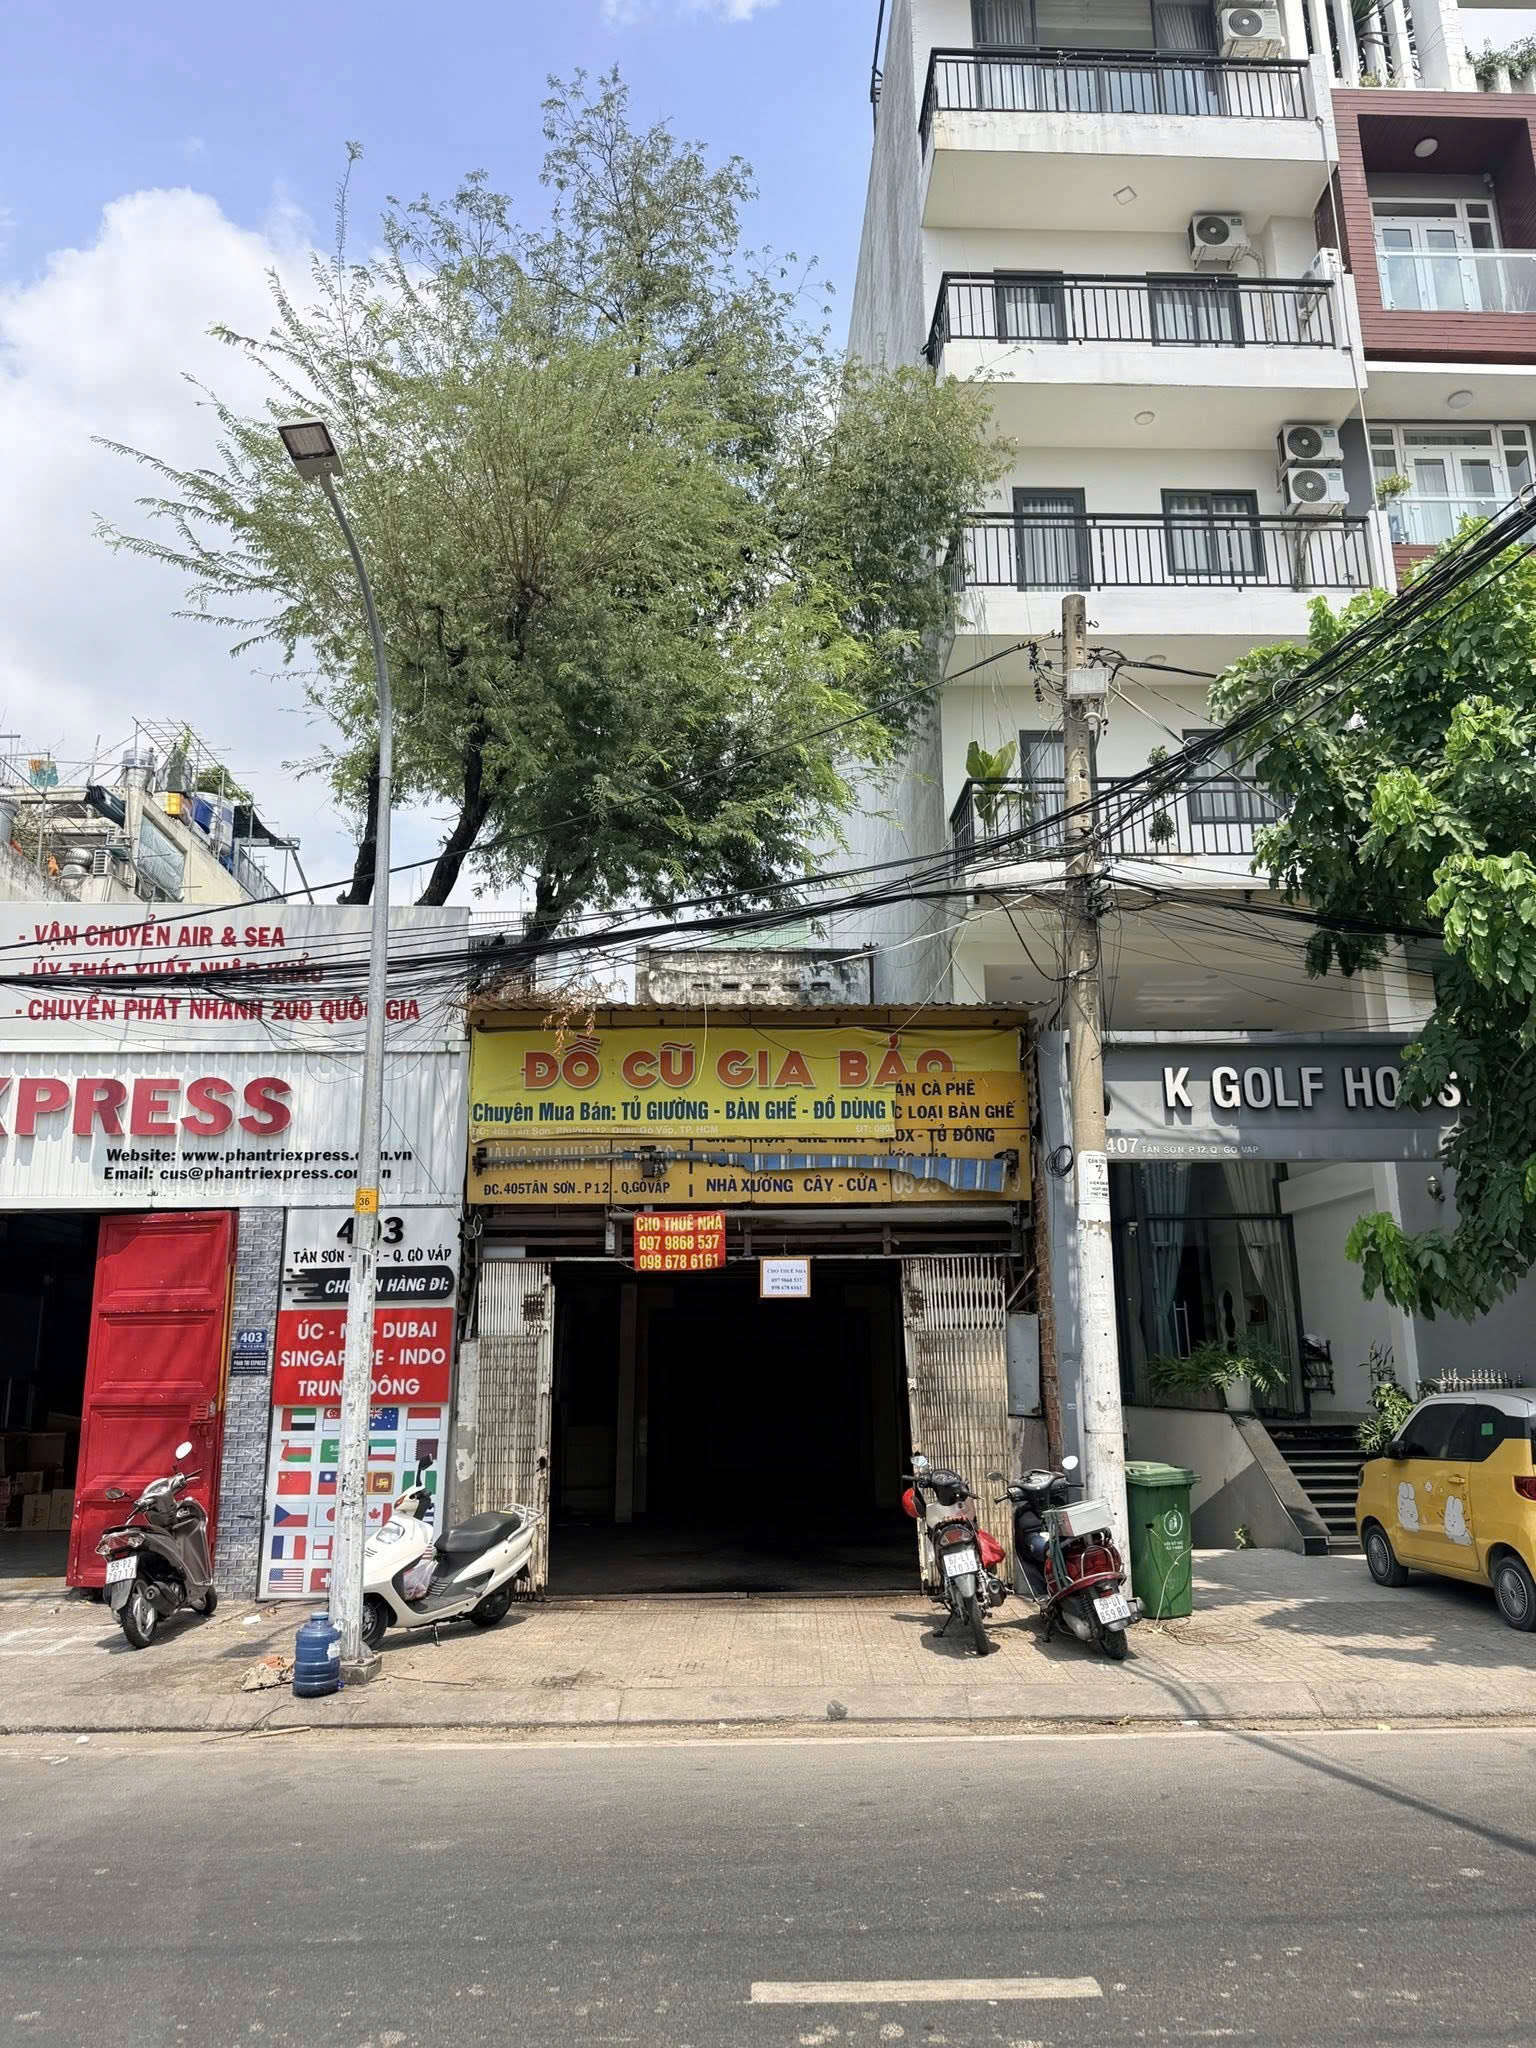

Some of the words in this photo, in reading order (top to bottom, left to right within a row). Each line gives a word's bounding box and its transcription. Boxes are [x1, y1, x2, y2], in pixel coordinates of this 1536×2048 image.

[178, 926, 213, 946] AIR
[221, 926, 237, 947] &
[245, 926, 285, 947] SEA
[190, 999, 263, 1020] NHANH
[271, 1000, 313, 1021] 200
[386, 999, 420, 1021] GIA
[520, 1033, 602, 1089] ĐỒ
[621, 1040, 696, 1089] CŨ
[716, 1049, 816, 1088] GIA
[839, 1033, 954, 1088] BẢO
[895, 1079, 916, 1096] ÁN
[922, 1078, 942, 1096] CÀ
[946, 1079, 976, 1096] PHÊ
[1163, 1066, 1193, 1107] K
[1212, 1066, 1324, 1108] GOLF
[1344, 1066, 1473, 1108] HOS
[472, 1102, 533, 1124] Chuyên
[539, 1102, 575, 1121] Mua
[580, 1101, 616, 1121] Bán:
[622, 1095, 641, 1120] TỦ
[647, 1096, 709, 1120] GIƯỜNG
[725, 1097, 760, 1119] BÀN
[765, 1094, 799, 1119] GHẾ
[813, 1094, 836, 1119] ĐỒ
[841, 1096, 886, 1119] DÙNG
[908, 1105, 943, 1121] LOẠI
[948, 1102, 980, 1119] BÀN
[985, 1099, 1016, 1118] GHẾ
[696, 1126, 719, 1134] HCM
[928, 1124, 947, 1142] TỦ
[1106, 1137, 1139, 1153] 407
[107, 1148, 176, 1161] Website:
[182, 1148, 412, 1164] www.phantriexpress.m.vn
[104, 1166, 153, 1180] Email:
[160, 1166, 392, 1181] cus@phantriexpress.con
[706, 1174, 737, 1192] NHÀ
[741, 1172, 794, 1193] XƯỞNG
[804, 1175, 834, 1192] CÂY
[847, 1172, 878, 1192] CỬA
[359, 1197, 370, 1206] 36
[337, 1216, 404, 1244] 43
[636, 1216, 660, 1231] CHO
[664, 1214, 694, 1231] THUÊ
[698, 1212, 723, 1230] NHÀ
[639, 1236, 661, 1250] 097
[665, 1235, 694, 1250] 9868
[698, 1234, 720, 1249] 537
[293, 1248, 317, 1263] TÂN
[321, 1248, 345, 1262] SƠN
[393, 1249, 404, 1262] Q.
[408, 1247, 425, 1261] GÒ
[428, 1244, 452, 1261] VẤP
[639, 1255, 661, 1269] 098
[665, 1254, 687, 1269] 678
[690, 1253, 719, 1268] 6161
[325, 1279, 383, 1294] CHUN
[387, 1275, 426, 1292] HÀNG
[429, 1277, 449, 1291] ĐI:
[240, 1332, 263, 1343] 403
[298, 1319, 324, 1340] ÚC
[383, 1322, 437, 1339] DUBAI
[280, 1349, 384, 1367] SINGAPE
[400, 1348, 446, 1365] INDO
[298, 1380, 343, 1396] TRUN
